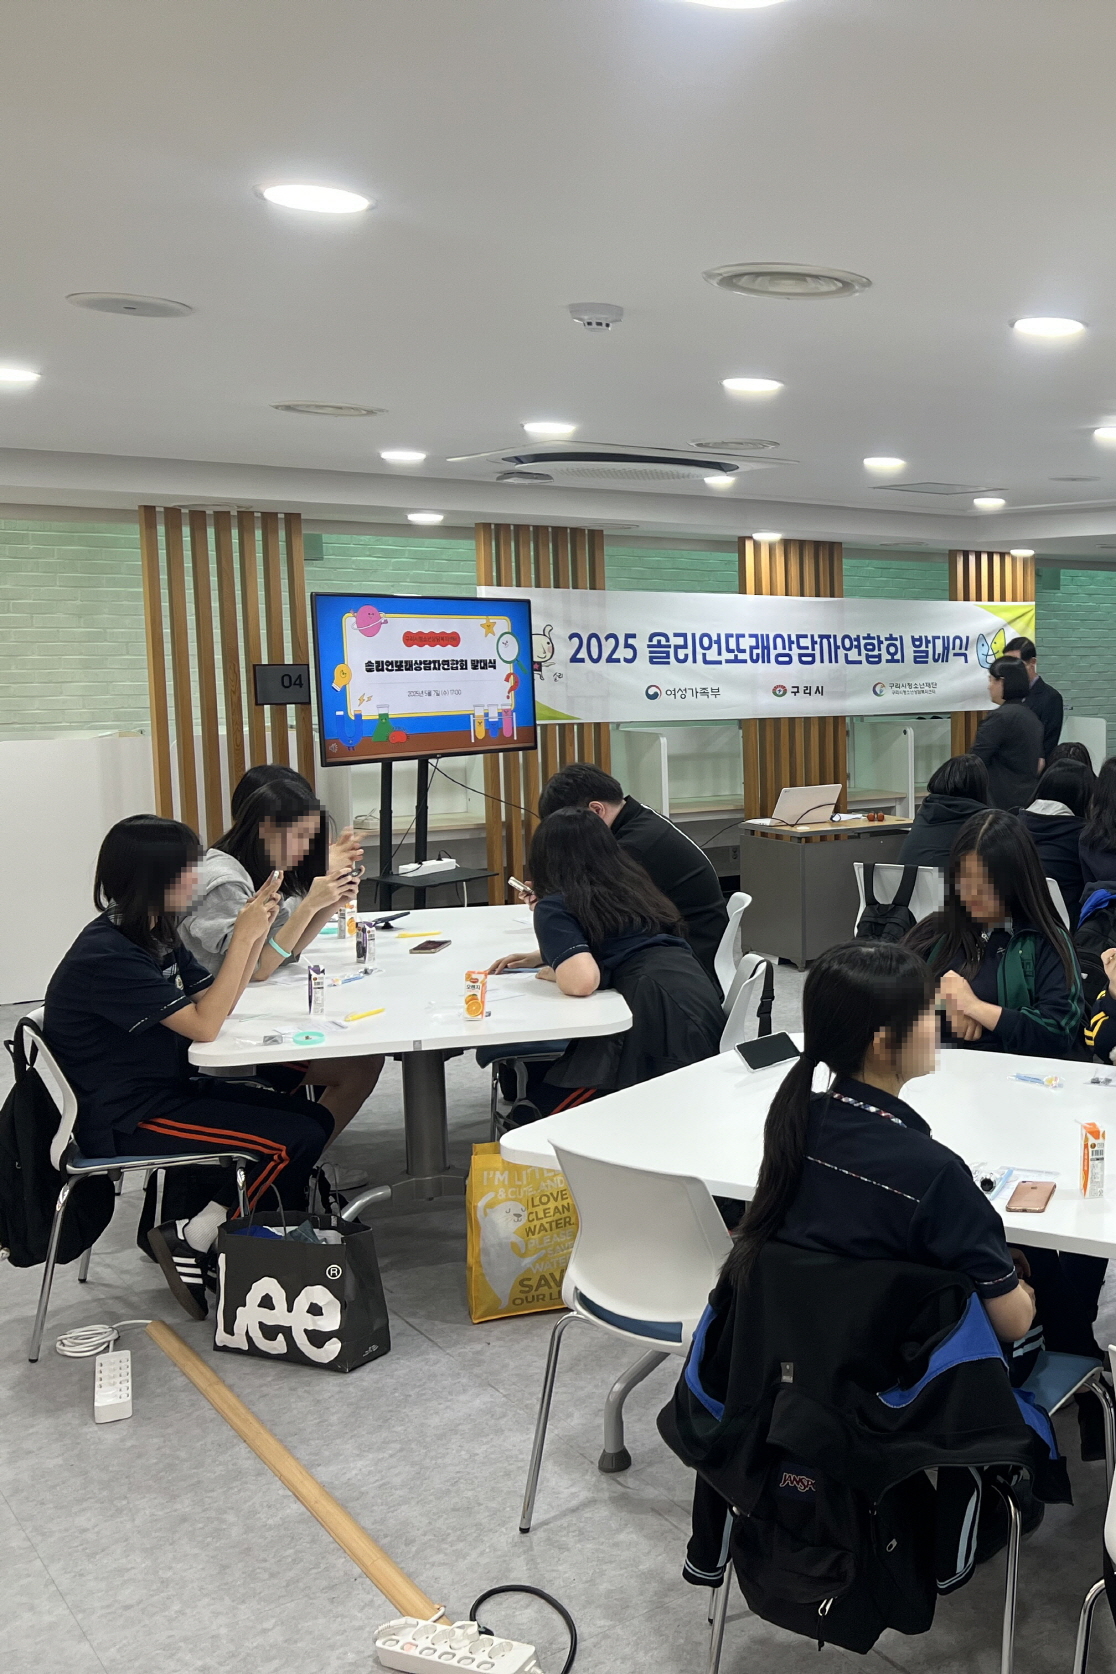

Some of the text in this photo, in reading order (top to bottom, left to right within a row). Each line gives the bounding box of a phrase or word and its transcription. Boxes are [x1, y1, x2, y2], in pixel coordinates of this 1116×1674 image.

[567, 631, 970, 666] 2025 솔리언또래상담자연합회 발대식
[364, 659, 497, 673] 솔리언또래상담자연합회 발대식
[281, 673, 304, 689] 04
[790, 685, 825, 697] 구리시
[888, 681, 938, 690] 구리시청소년재단
[665, 686, 721, 700] 여성가족부
[482, 1166, 562, 1186] I'M LITTL
[531, 1188, 569, 1208] LOVE
[527, 1202, 571, 1222] CLEAN
[524, 1216, 575, 1238] WATER.
[527, 1228, 574, 1250] PLEASE
[518, 1268, 567, 1295] SAV
[215, 1252, 342, 1364] Lee
[511, 1293, 546, 1307] OUR
[779, 1472, 816, 1492] JANSP
